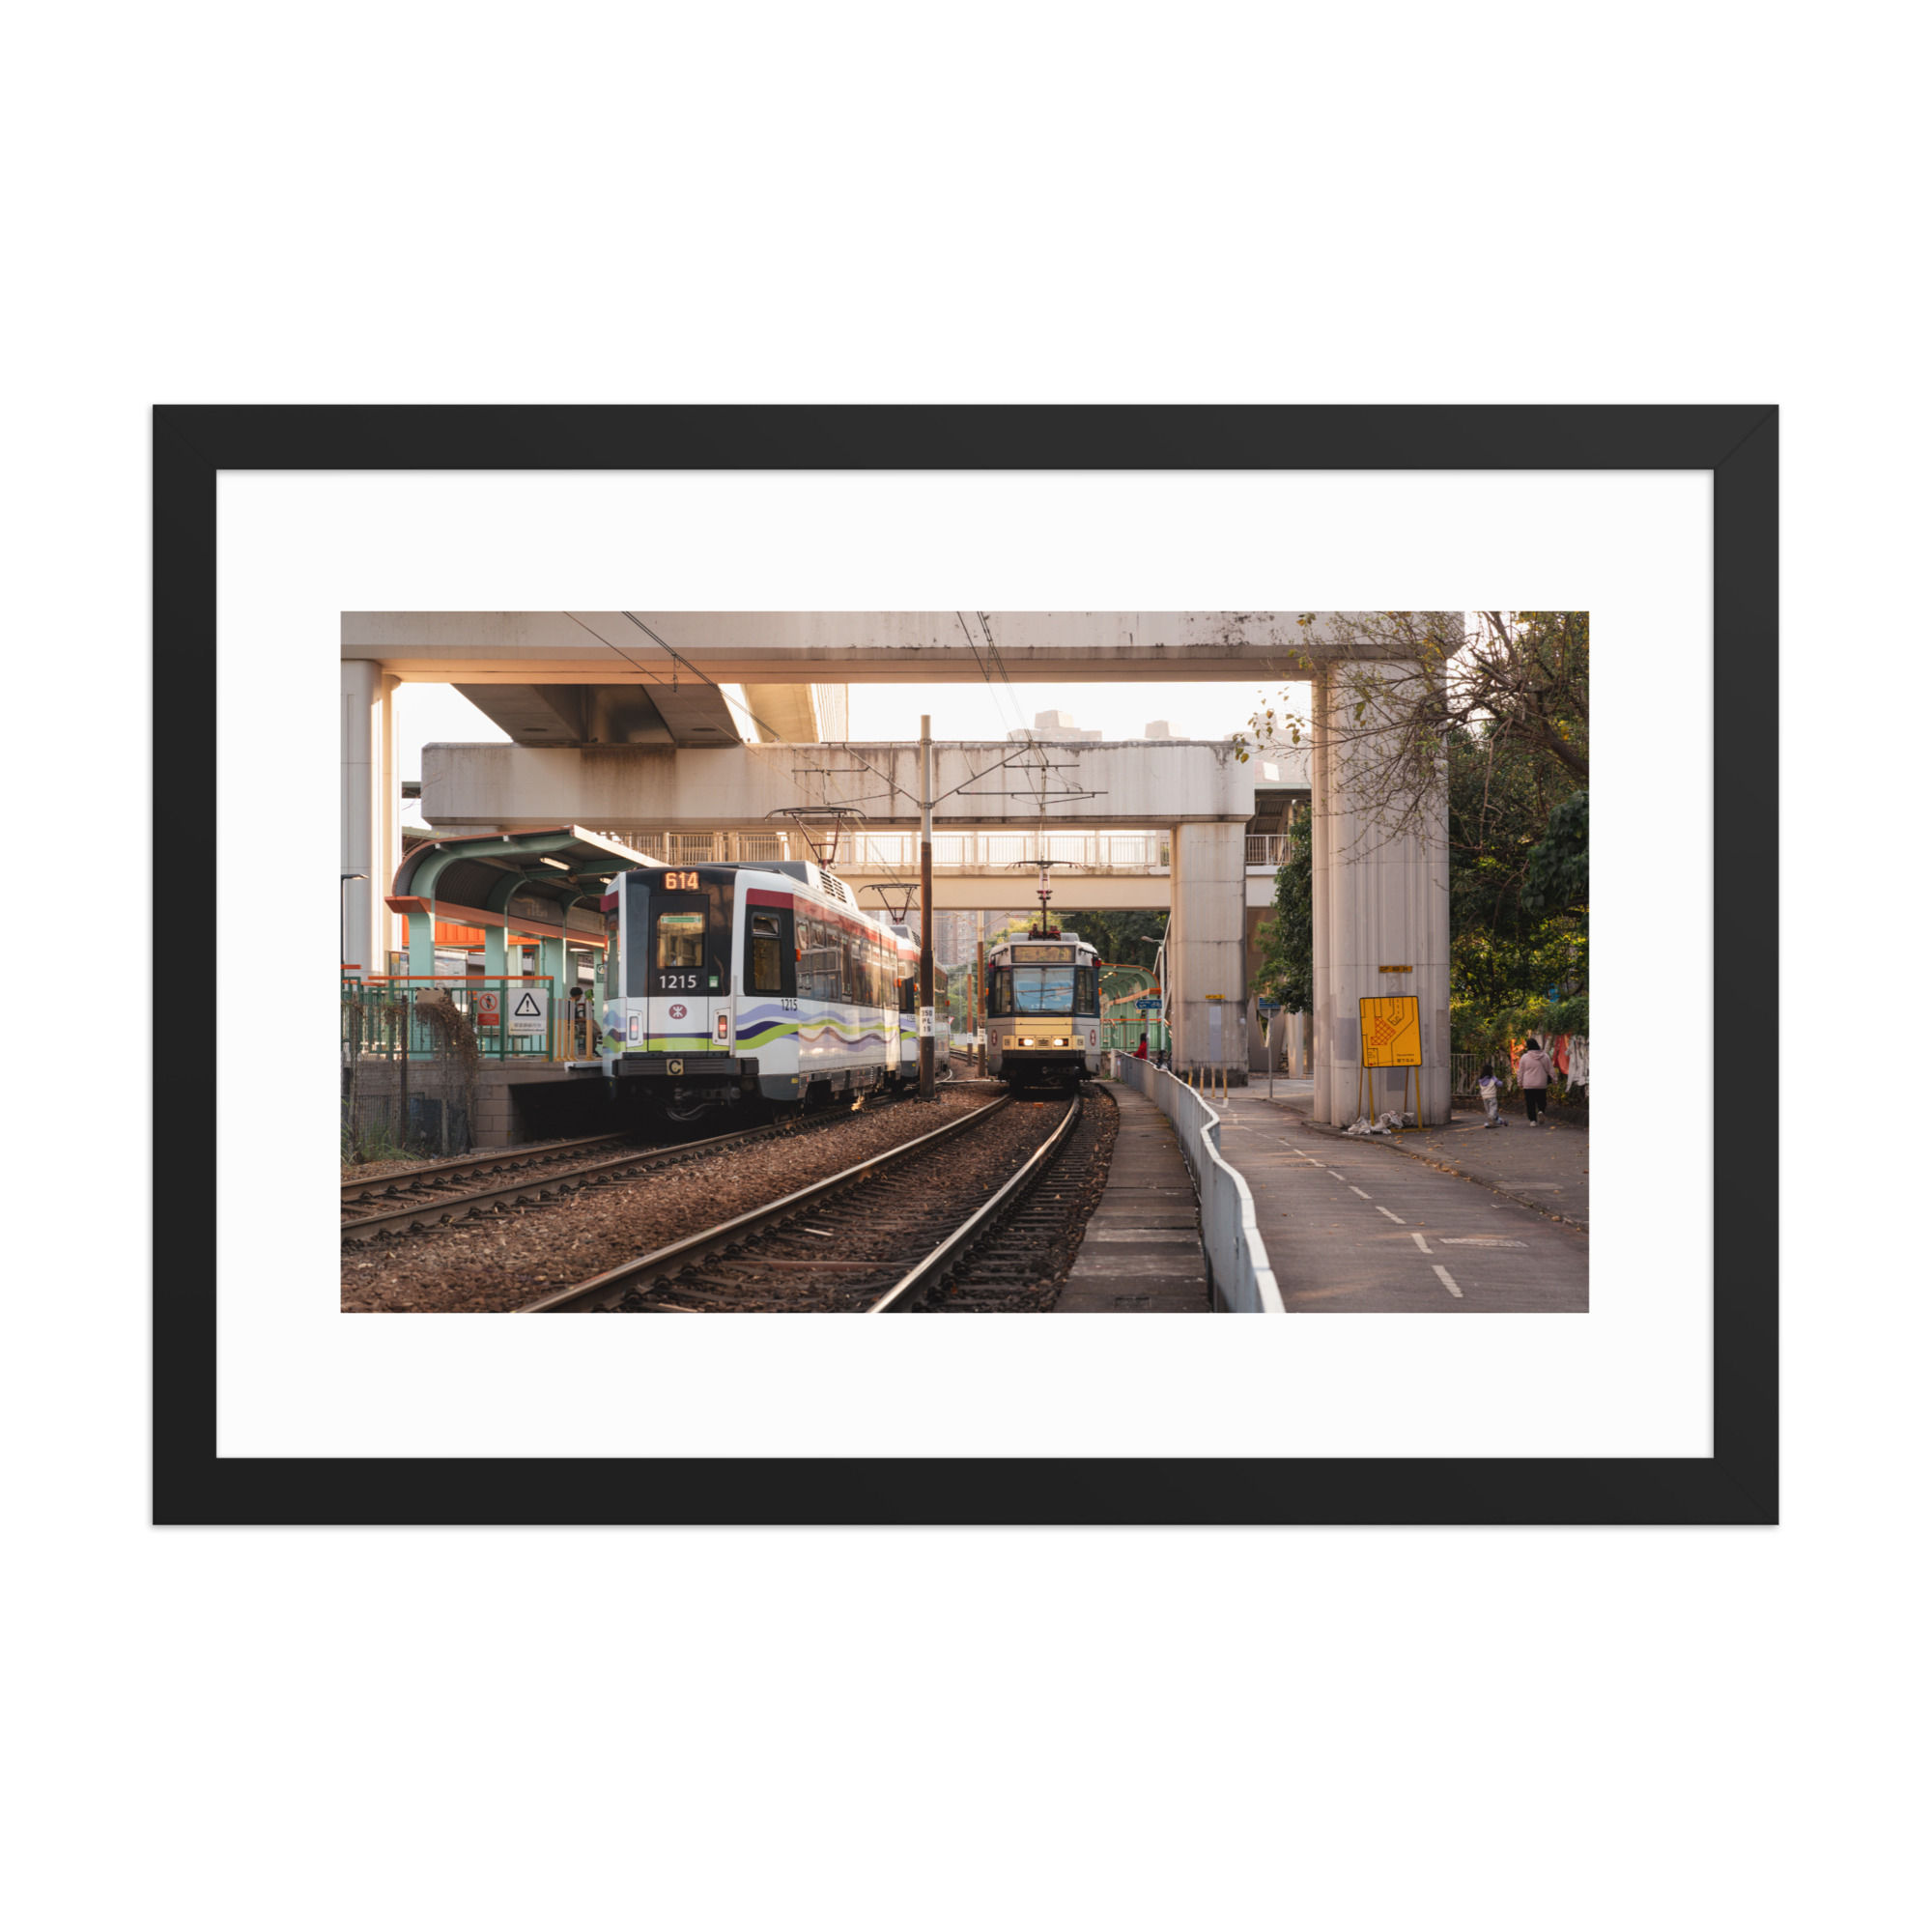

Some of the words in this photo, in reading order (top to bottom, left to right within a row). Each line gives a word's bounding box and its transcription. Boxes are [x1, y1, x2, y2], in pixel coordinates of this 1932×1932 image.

[666, 871, 698, 890] 614
[659, 975, 696, 989] 1215
[781, 998, 798, 1011] 1215
[668, 1060, 682, 1075] C
